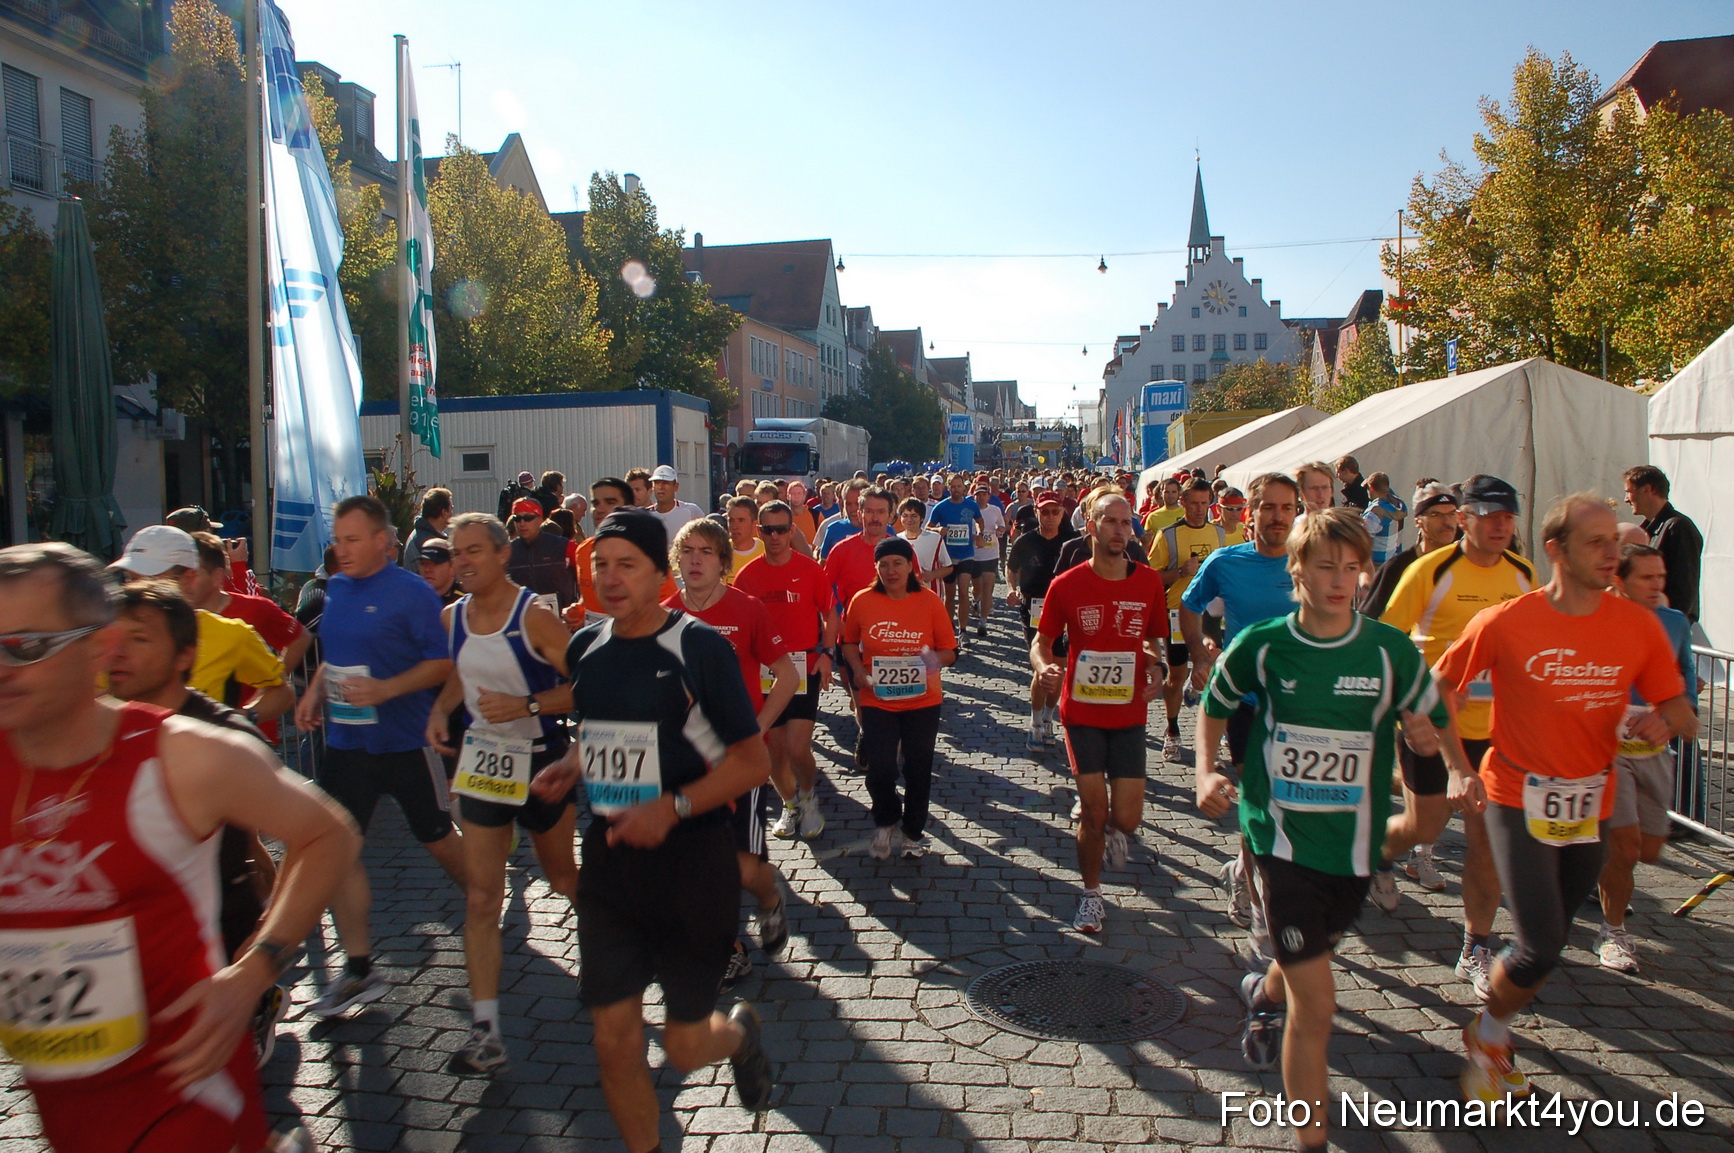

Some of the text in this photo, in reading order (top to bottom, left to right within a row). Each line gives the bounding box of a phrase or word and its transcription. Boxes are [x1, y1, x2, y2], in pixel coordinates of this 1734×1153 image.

[1449, 343, 1455, 367] P
[1151, 388, 1182, 406] maxi
[949, 529, 968, 538] 2877
[1082, 618, 1100, 627] NEU
[877, 629, 924, 640] Fischer
[878, 668, 921, 685] 2252
[1088, 665, 1123, 685] 373
[1543, 661, 1624, 678] Fischer
[1333, 675, 1382, 691] JURA
[1551, 678, 1618, 686] AUTOMOBILE
[886, 685, 914, 697] Sigrid
[474, 749, 514, 779] 289
[585, 744, 647, 782] 2197
[1281, 746, 1359, 783] 3220
[467, 774, 517, 796] Gerhard
[1284, 781, 1350, 802] Thomas
